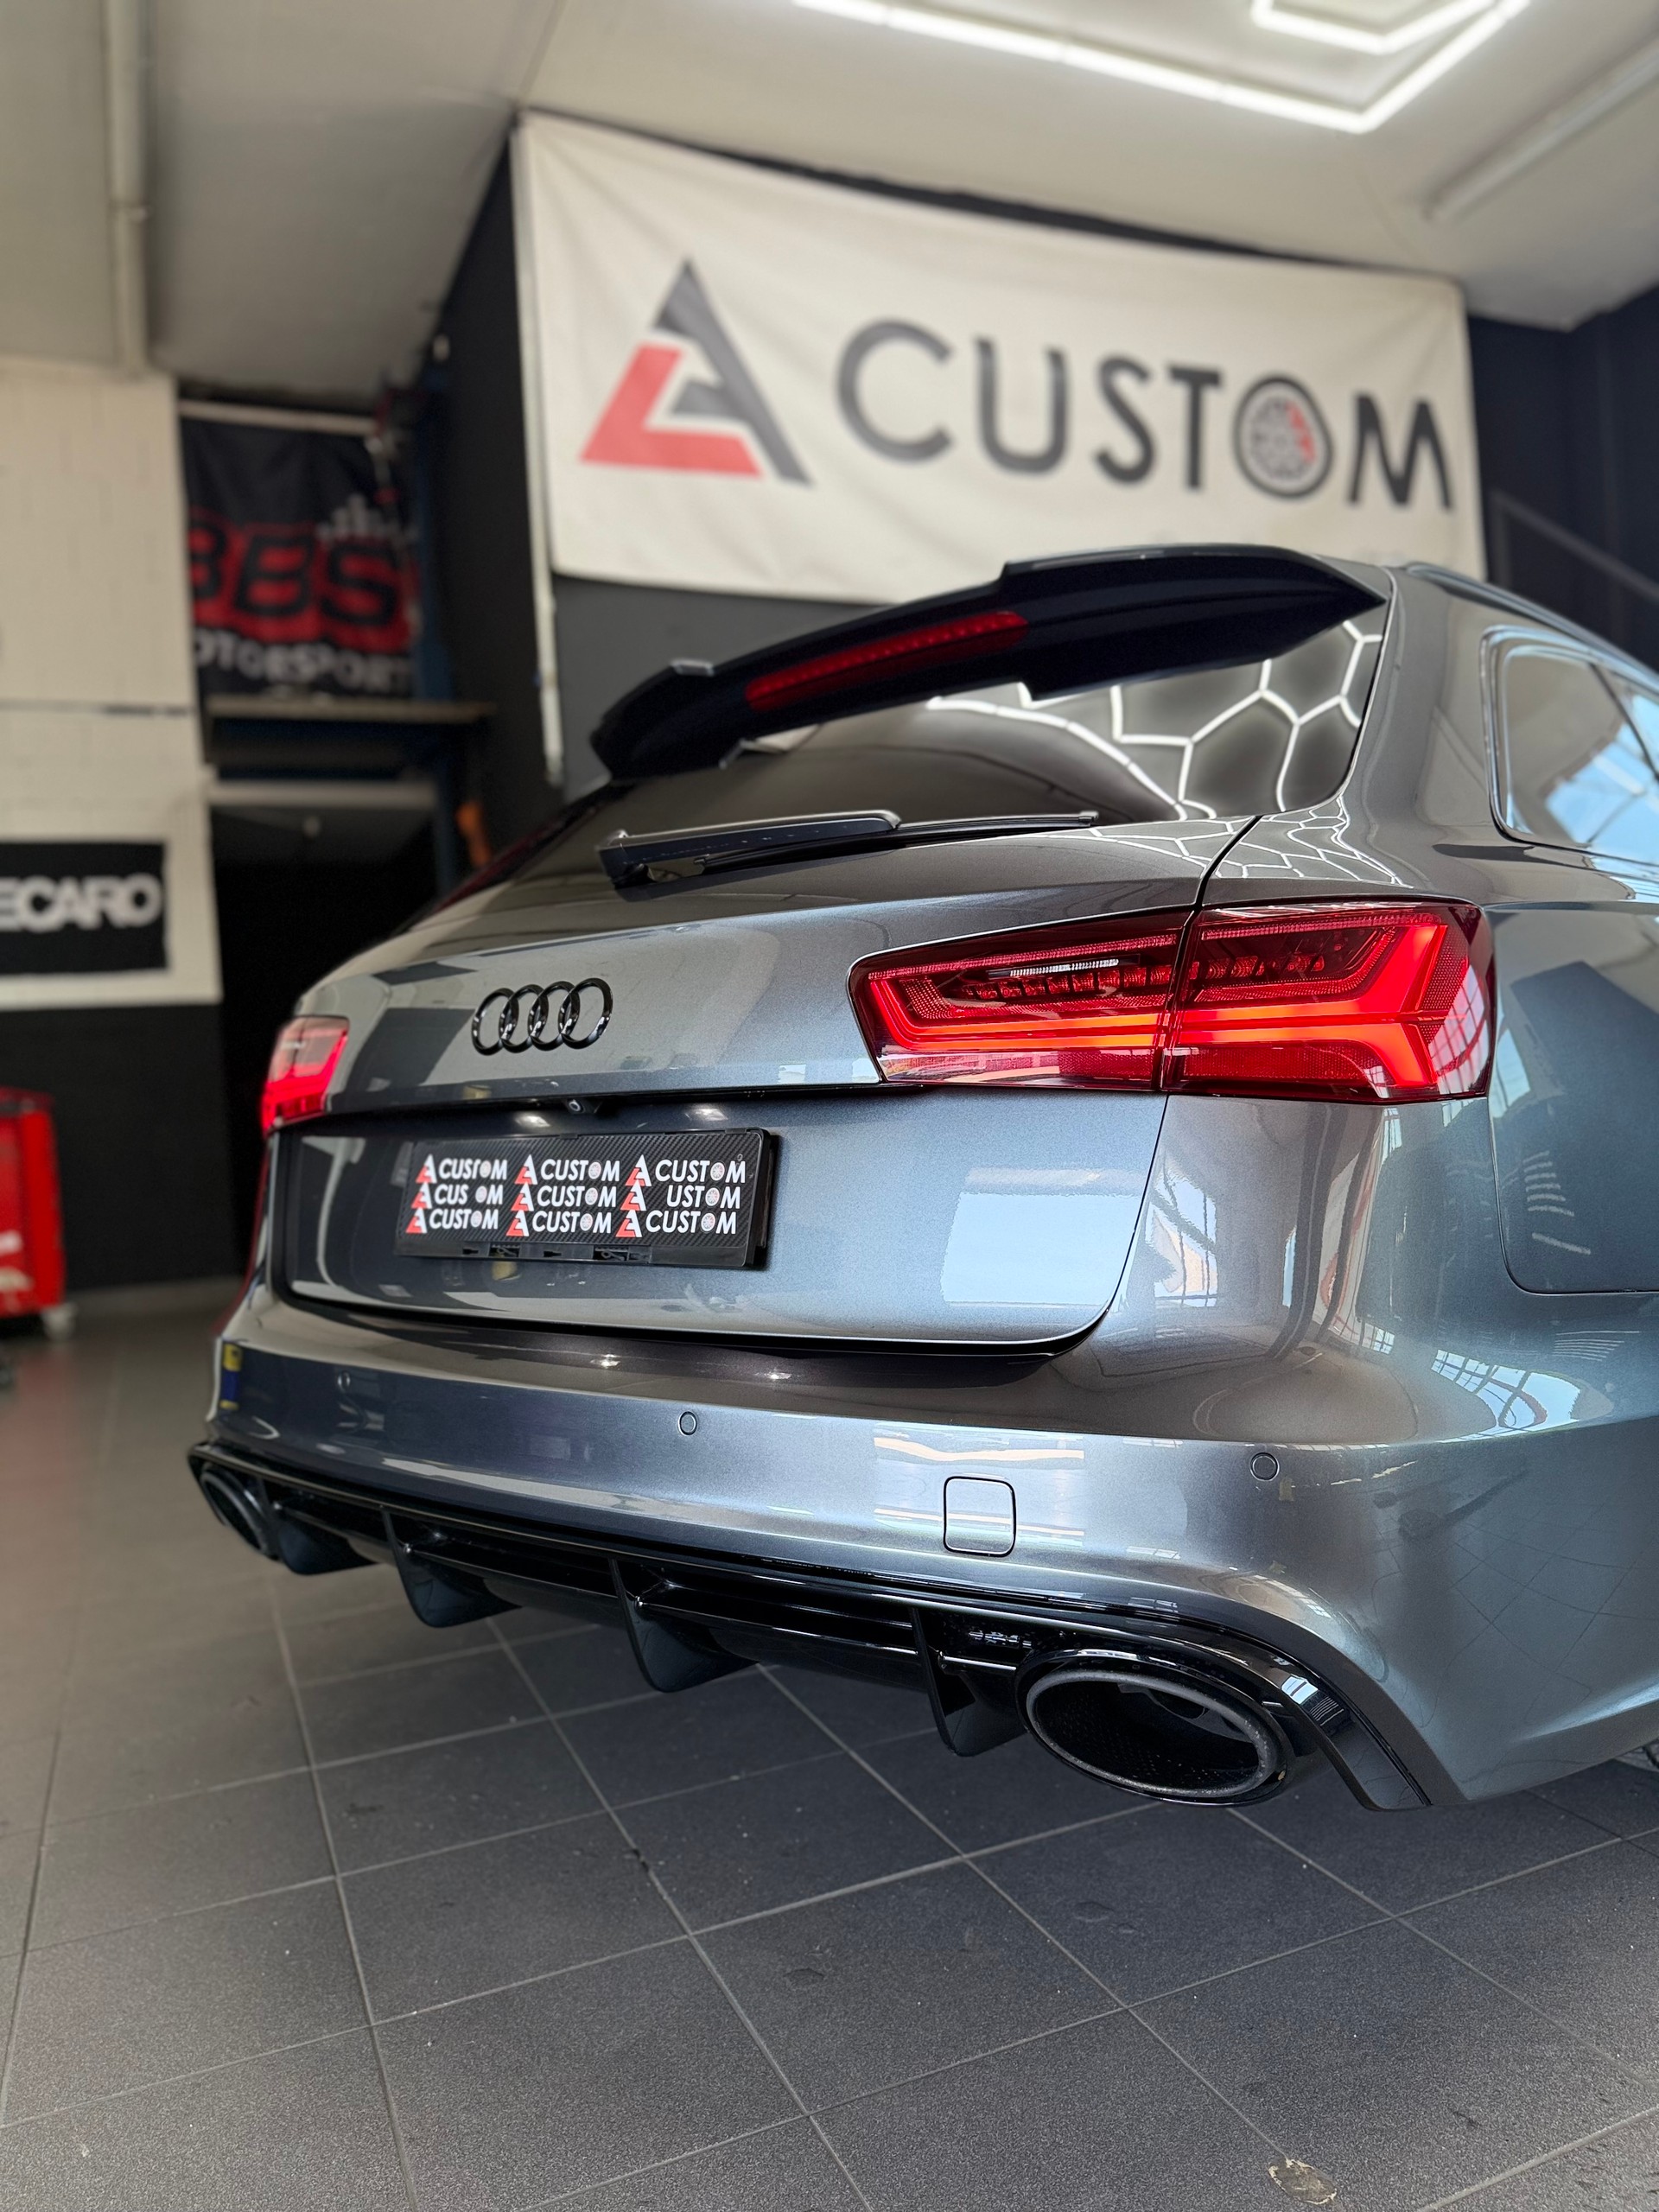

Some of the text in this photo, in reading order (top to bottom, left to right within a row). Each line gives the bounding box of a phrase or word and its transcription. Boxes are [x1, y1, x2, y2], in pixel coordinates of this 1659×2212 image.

[836, 316, 1454, 512] CUSTOM
[194, 626, 411, 693] OTORSPORT
[0, 873, 163, 933] ECARO
[540, 1159, 620, 1182] CUSTOM
[655, 1159, 746, 1184] CUSTOM
[537, 1185, 617, 1207] CUSTOM
[429, 1208, 499, 1230] CUSTOM
[532, 1211, 612, 1234] CUSTOM
[645, 1210, 736, 1235] CUSTOM
